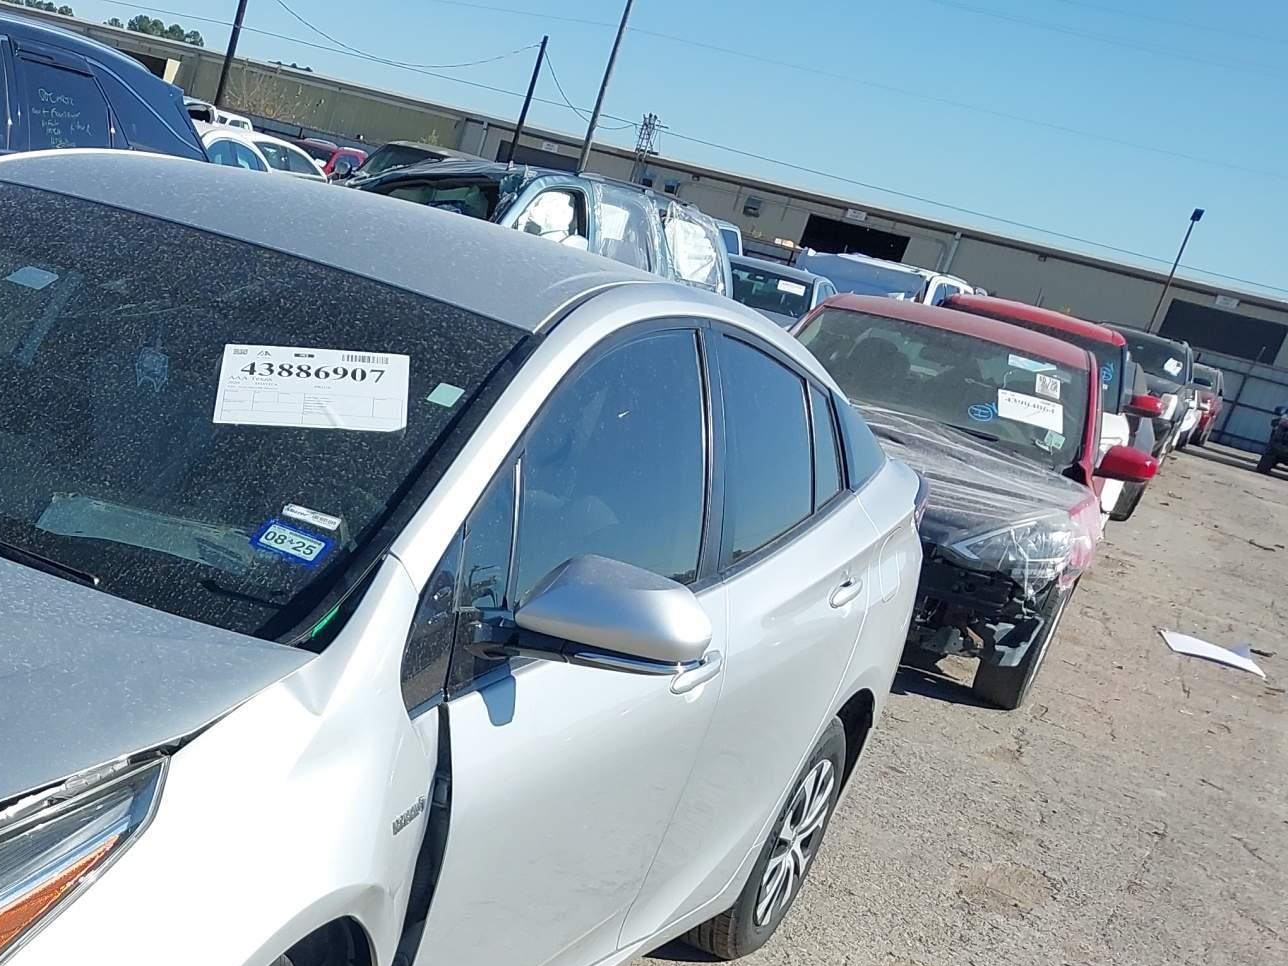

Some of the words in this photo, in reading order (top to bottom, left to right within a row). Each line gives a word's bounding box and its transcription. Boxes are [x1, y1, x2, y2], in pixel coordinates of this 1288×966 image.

[240, 361, 386, 384] 43886907
[264, 531, 287, 545] 08
[291, 541, 316, 556] 25
